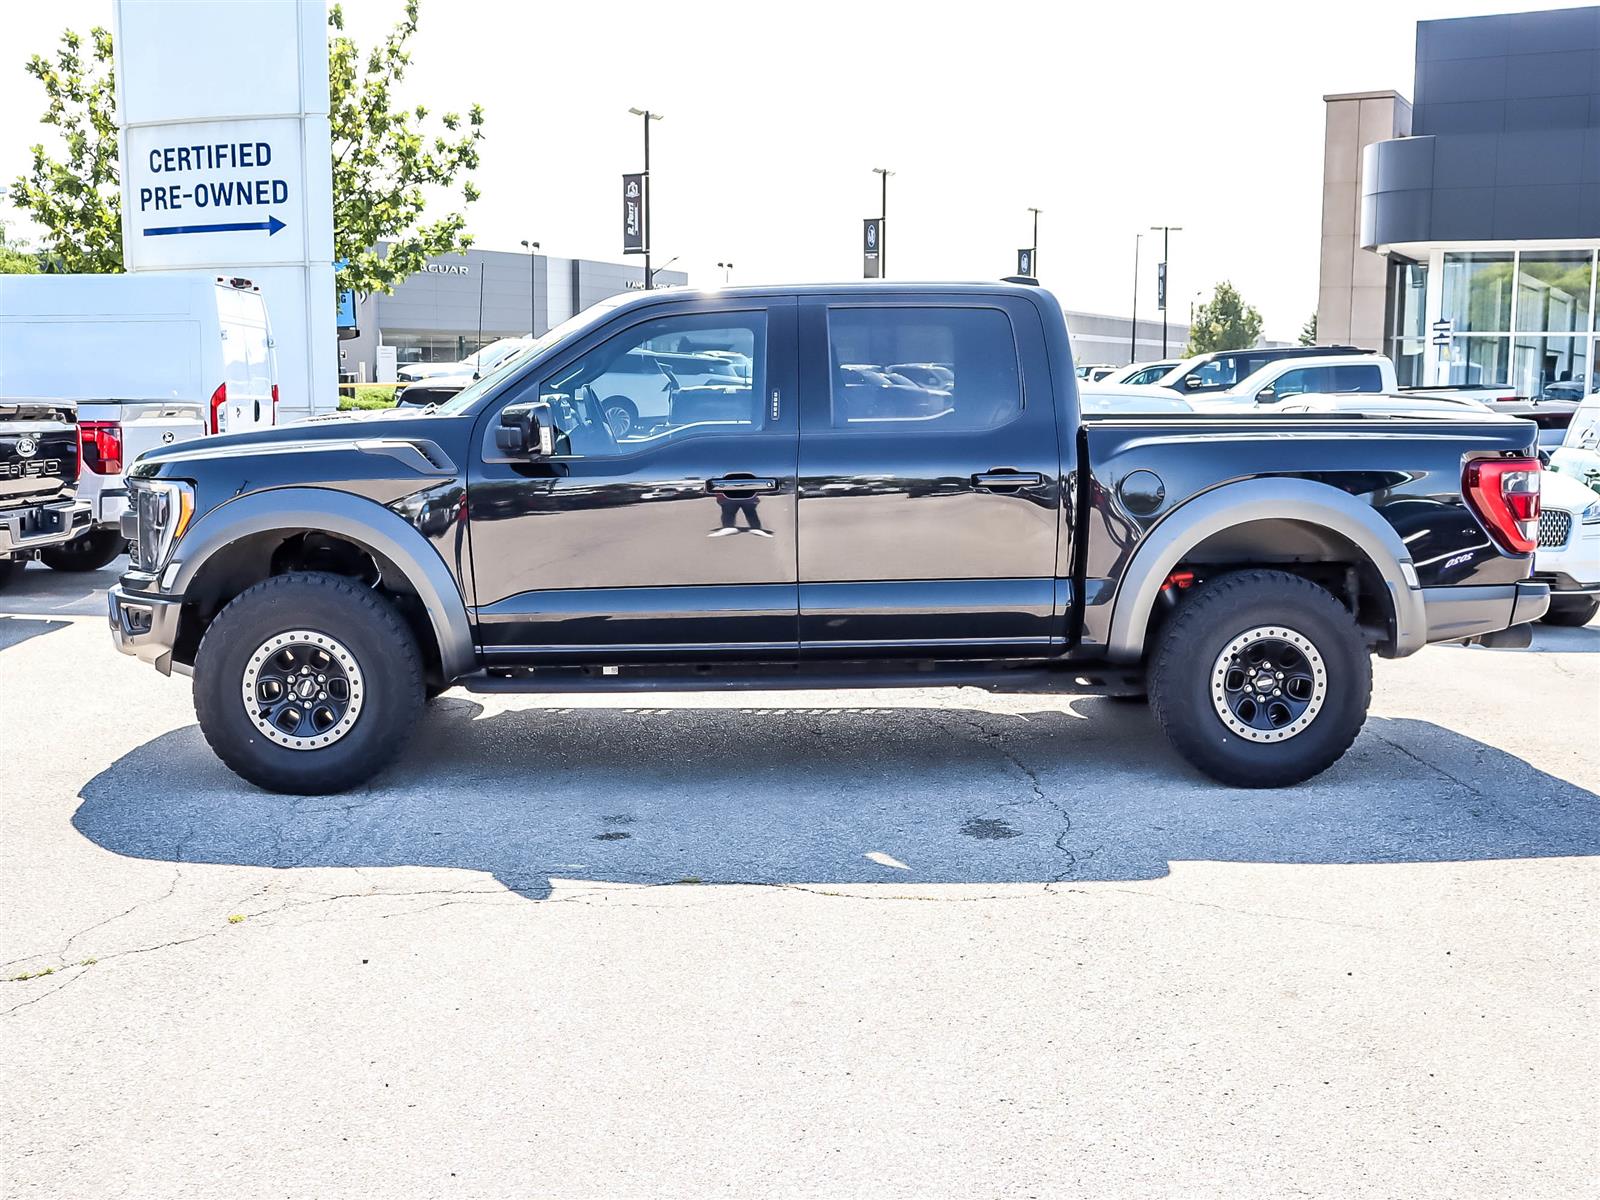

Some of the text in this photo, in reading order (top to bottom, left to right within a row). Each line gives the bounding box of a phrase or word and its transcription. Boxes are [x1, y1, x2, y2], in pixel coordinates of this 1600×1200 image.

[150, 142, 271, 173] CERTIFIED
[140, 180, 288, 211] PRE-OWNED
[420, 264, 469, 275] AGUAR
